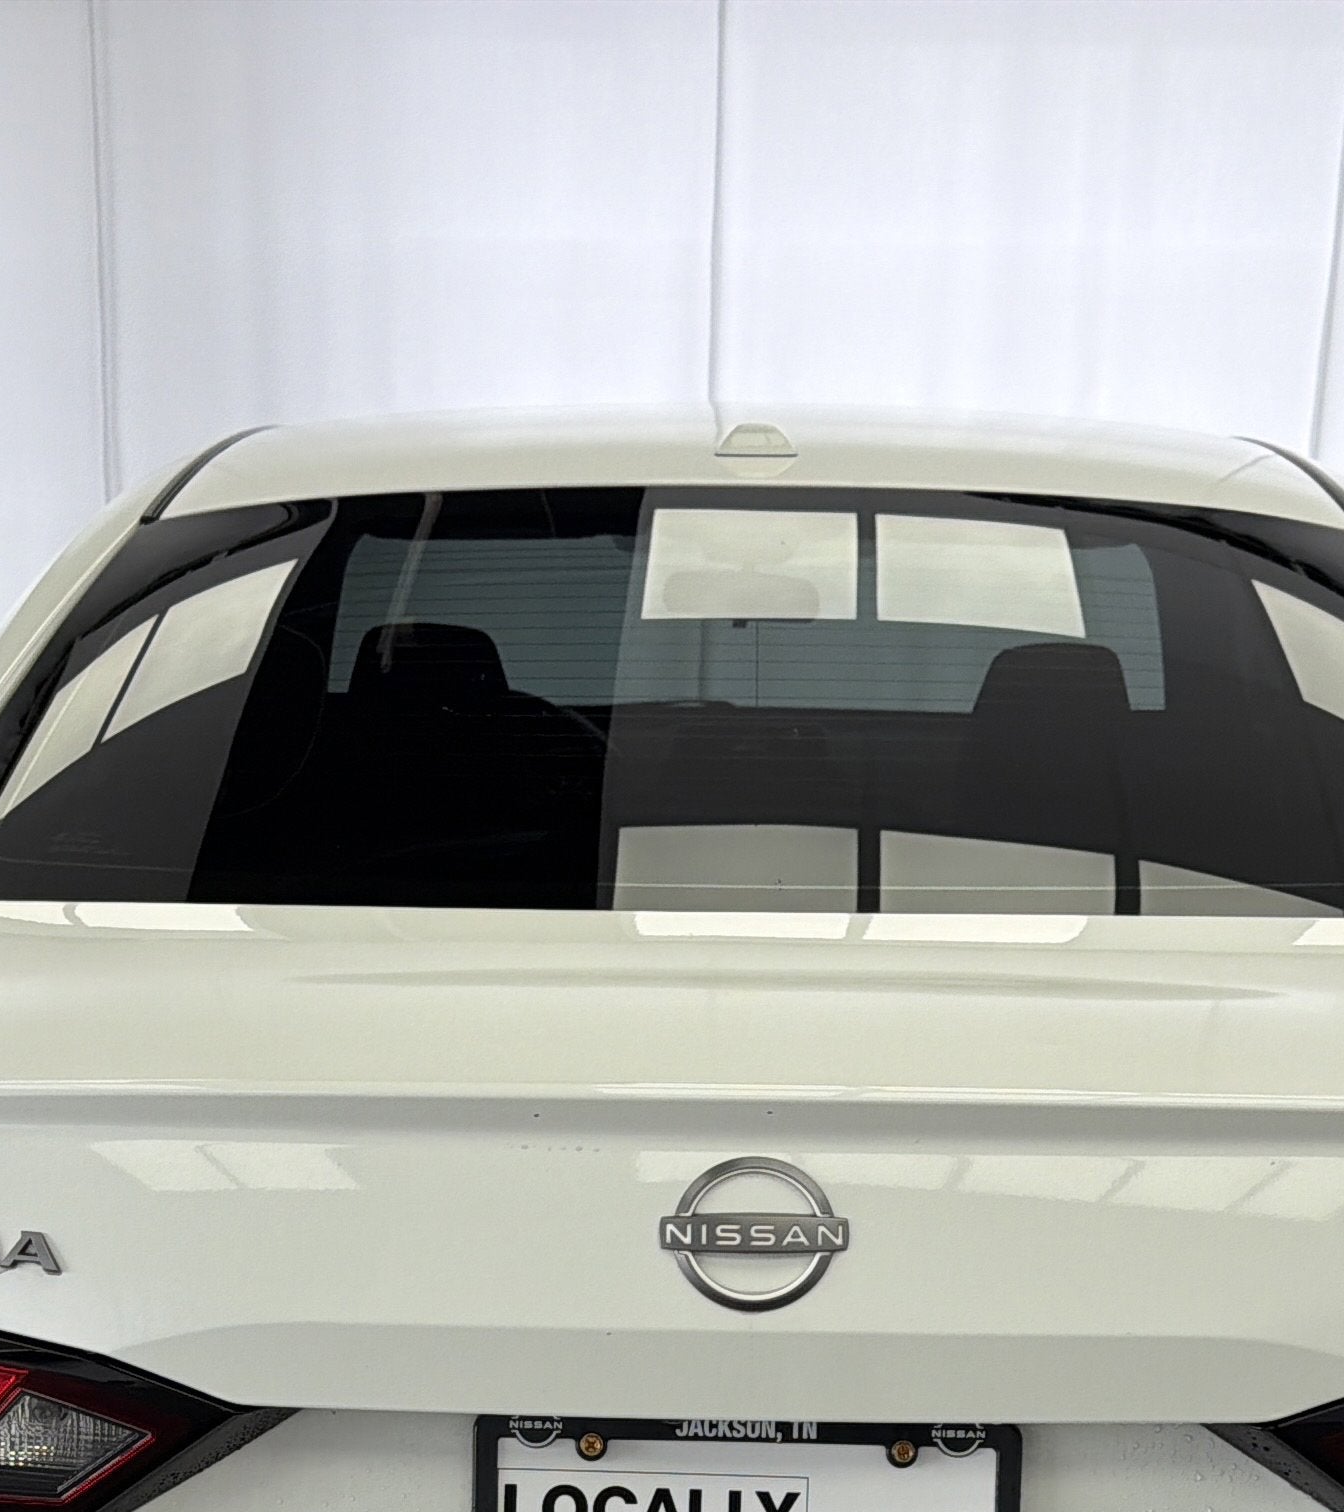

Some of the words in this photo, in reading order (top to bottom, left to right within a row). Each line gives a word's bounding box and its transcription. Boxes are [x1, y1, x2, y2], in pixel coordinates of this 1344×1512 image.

[665, 1223, 843, 1246] NISSAN
[509, 1420, 563, 1430] NISSAN
[931, 1429, 986, 1439] NISSAN
